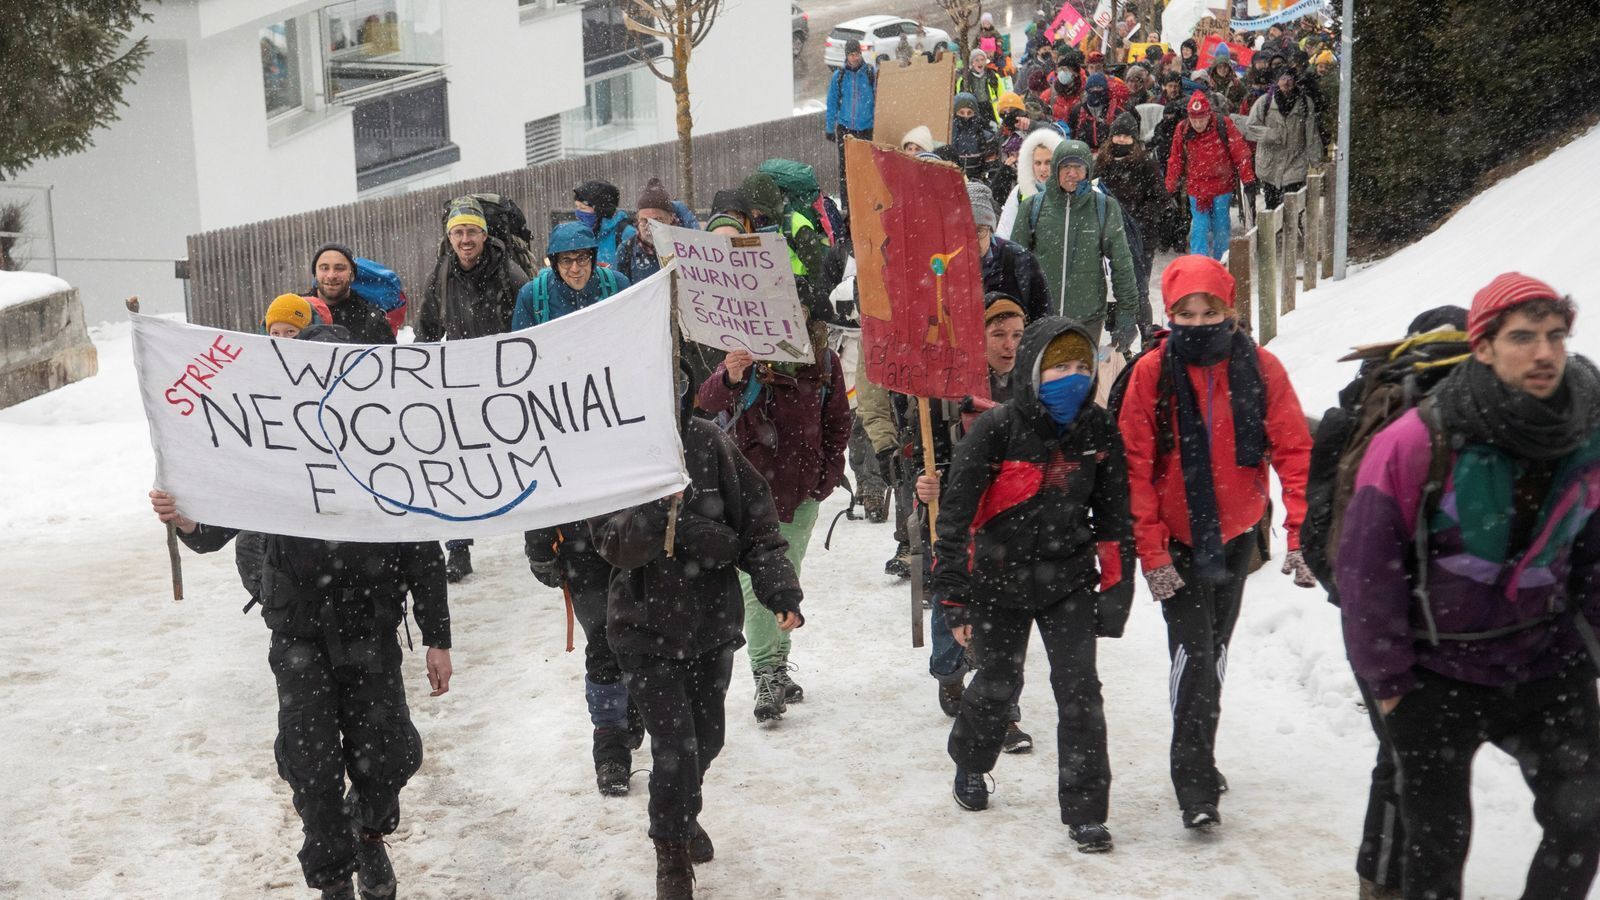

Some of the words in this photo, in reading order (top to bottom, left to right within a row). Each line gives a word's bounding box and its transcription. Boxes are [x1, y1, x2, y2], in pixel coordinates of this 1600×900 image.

[1096, 11, 1111, 28] NO
[673, 241, 725, 263] BALD
[729, 250, 775, 270] GITS
[711, 295, 769, 318] ZÜRI
[164, 334, 244, 417] STRIKE
[269, 337, 538, 392] WORLD
[198, 366, 646, 456] NEOCOLONIAL
[305, 445, 562, 516] FORUM
